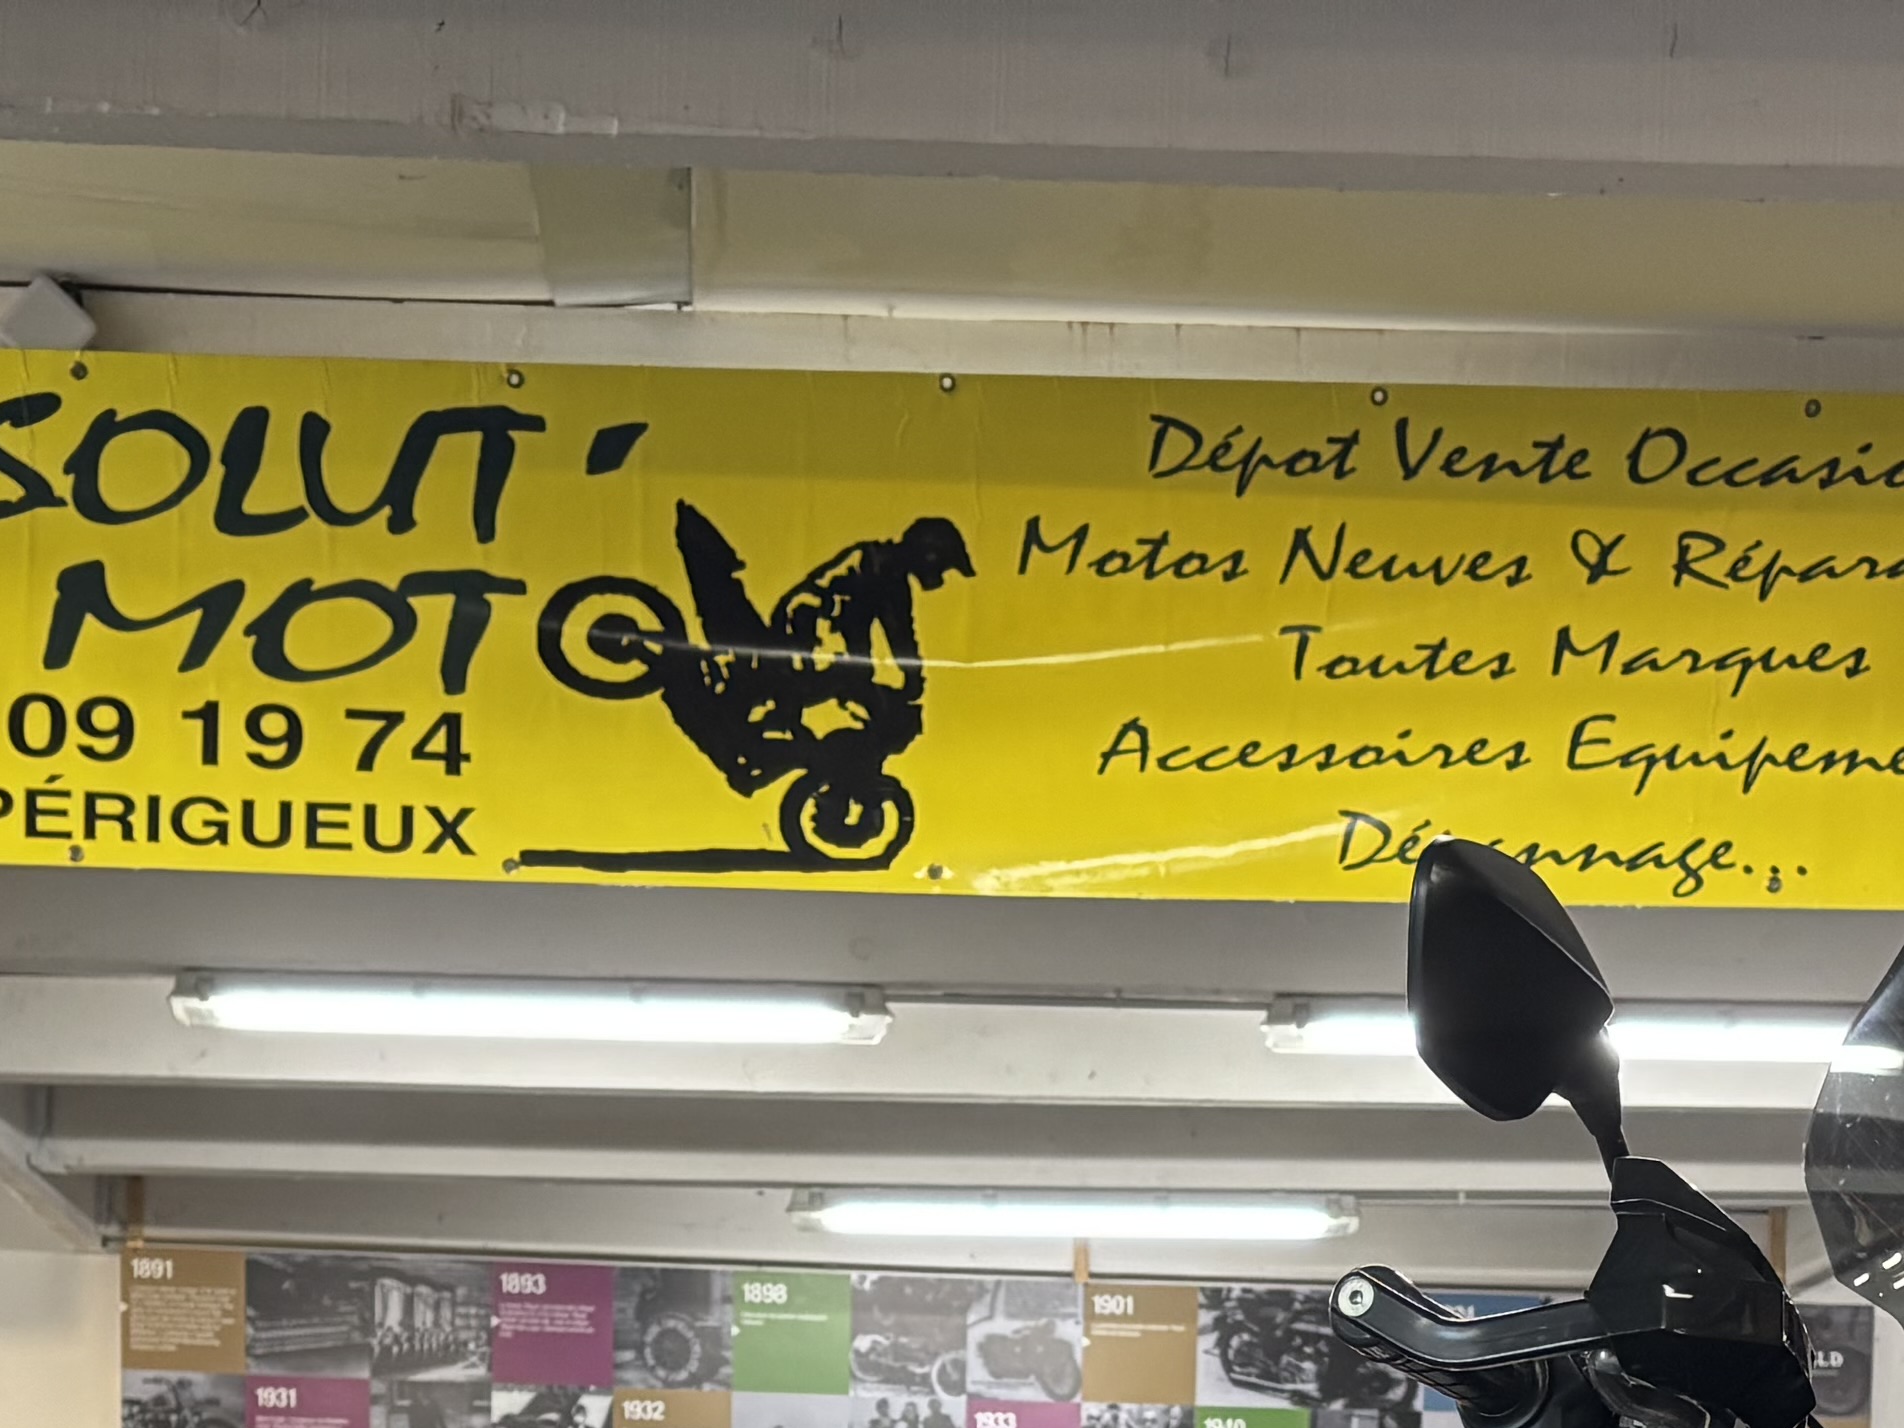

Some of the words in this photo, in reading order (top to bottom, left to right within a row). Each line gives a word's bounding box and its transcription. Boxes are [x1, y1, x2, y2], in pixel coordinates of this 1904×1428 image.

[1149, 414, 1360, 497] Dépot
[1395, 417, 1592, 484] Vente
[1018, 516, 1249, 581] Motos
[1280, 523, 1532, 587] Neuves
[1570, 529, 1630, 585] &
[1281, 624, 1516, 681] Toutes
[1552, 625, 1871, 697] Marques
[8, 693, 136, 762] 09
[182, 701, 304, 769] 19
[345, 709, 472, 776] 74
[1098, 718, 1530, 775] Accessoires
[1093, 1294, 1133, 1315] 1901
[256, 1387, 297, 1408] 1931
[623, 1400, 665, 1420] 1932
